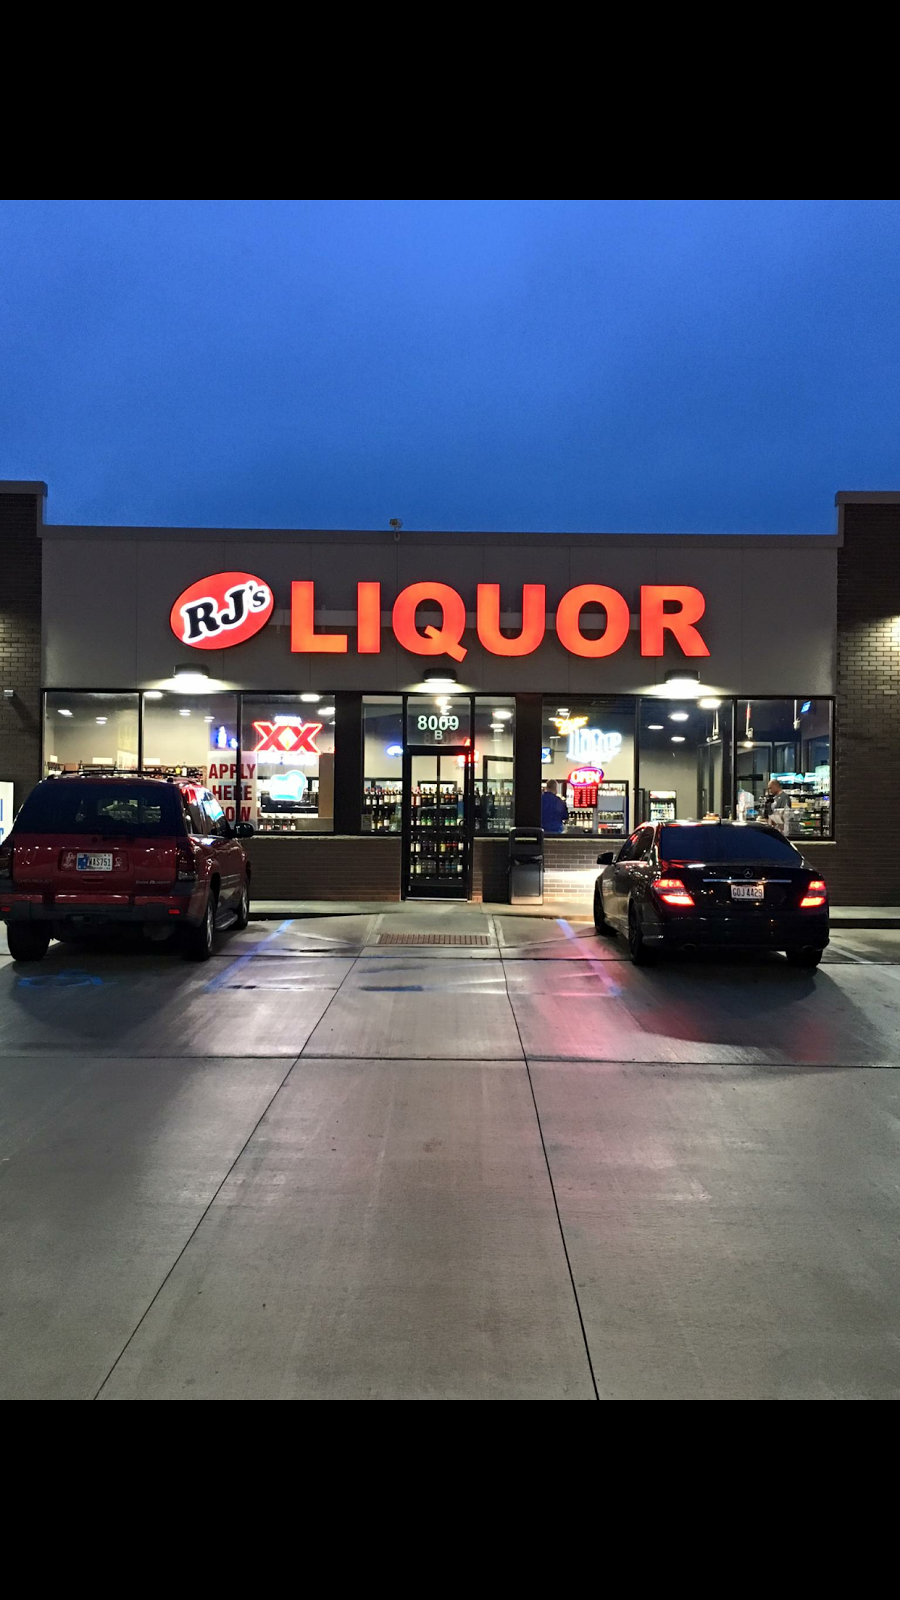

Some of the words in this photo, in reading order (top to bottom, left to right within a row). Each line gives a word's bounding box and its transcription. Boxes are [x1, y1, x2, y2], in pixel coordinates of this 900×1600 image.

[183, 583, 268, 641] RJ's
[291, 580, 711, 663] LIQUOR
[417, 715, 460, 731] 8009
[252, 721, 323, 756] XX
[434, 730, 443, 740] B
[209, 763, 256, 780] APPLY
[570, 770, 601, 784] OPEN
[221, 806, 251, 822] OW
